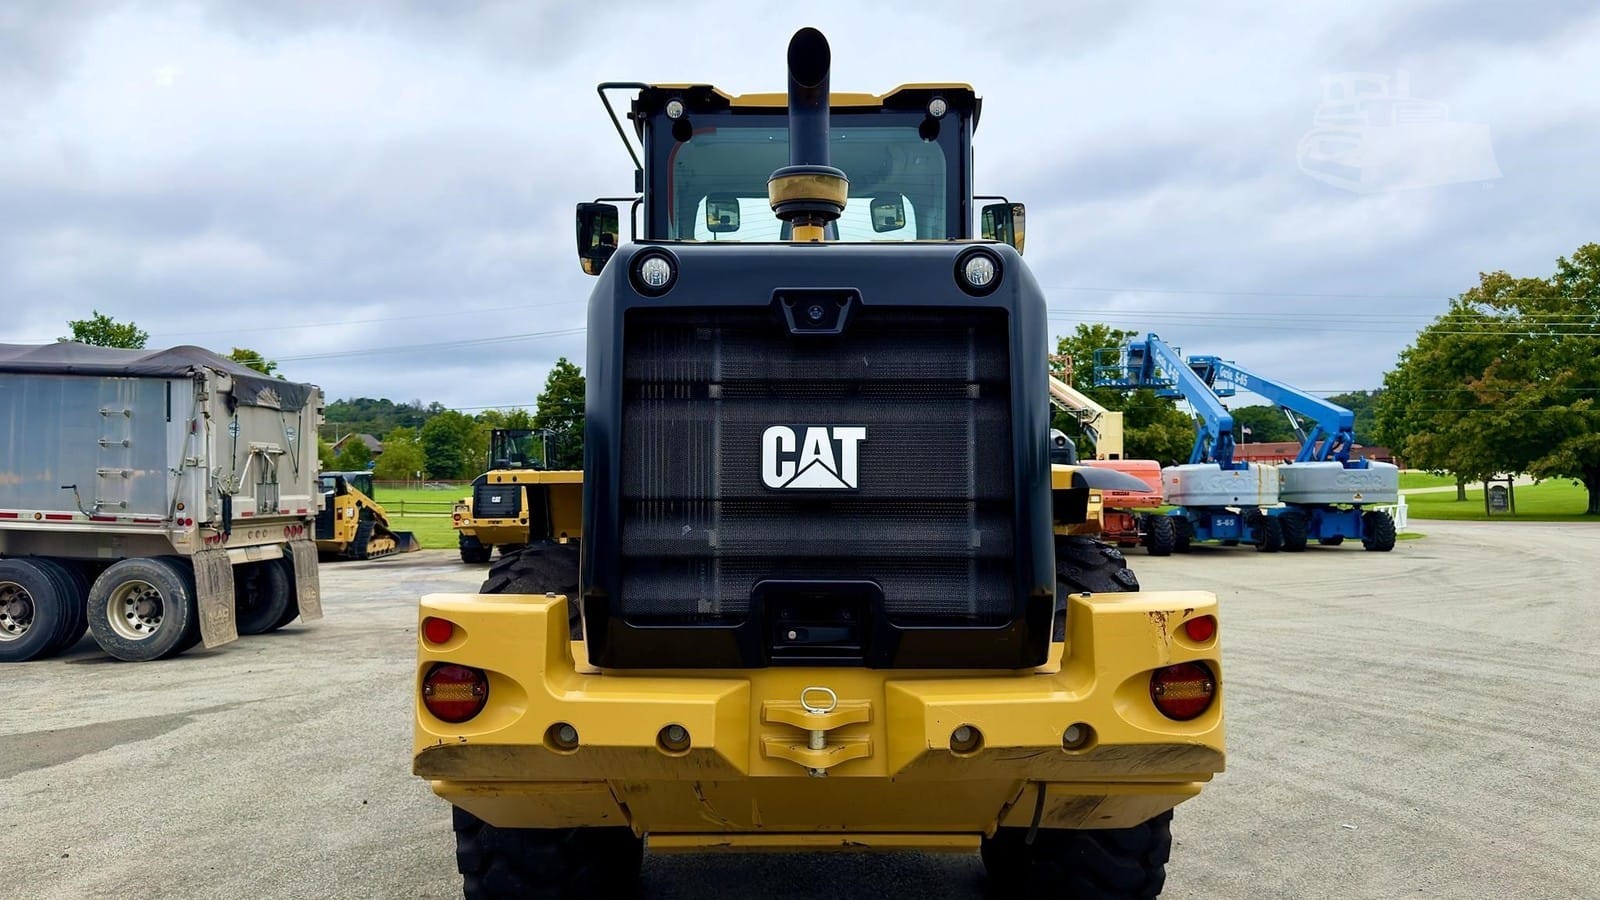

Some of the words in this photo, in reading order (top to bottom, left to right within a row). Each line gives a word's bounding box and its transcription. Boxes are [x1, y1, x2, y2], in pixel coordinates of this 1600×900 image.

[1219, 365, 1233, 381] Genie
[762, 425, 867, 489] CAT
[1216, 519, 1235, 527] S-65
